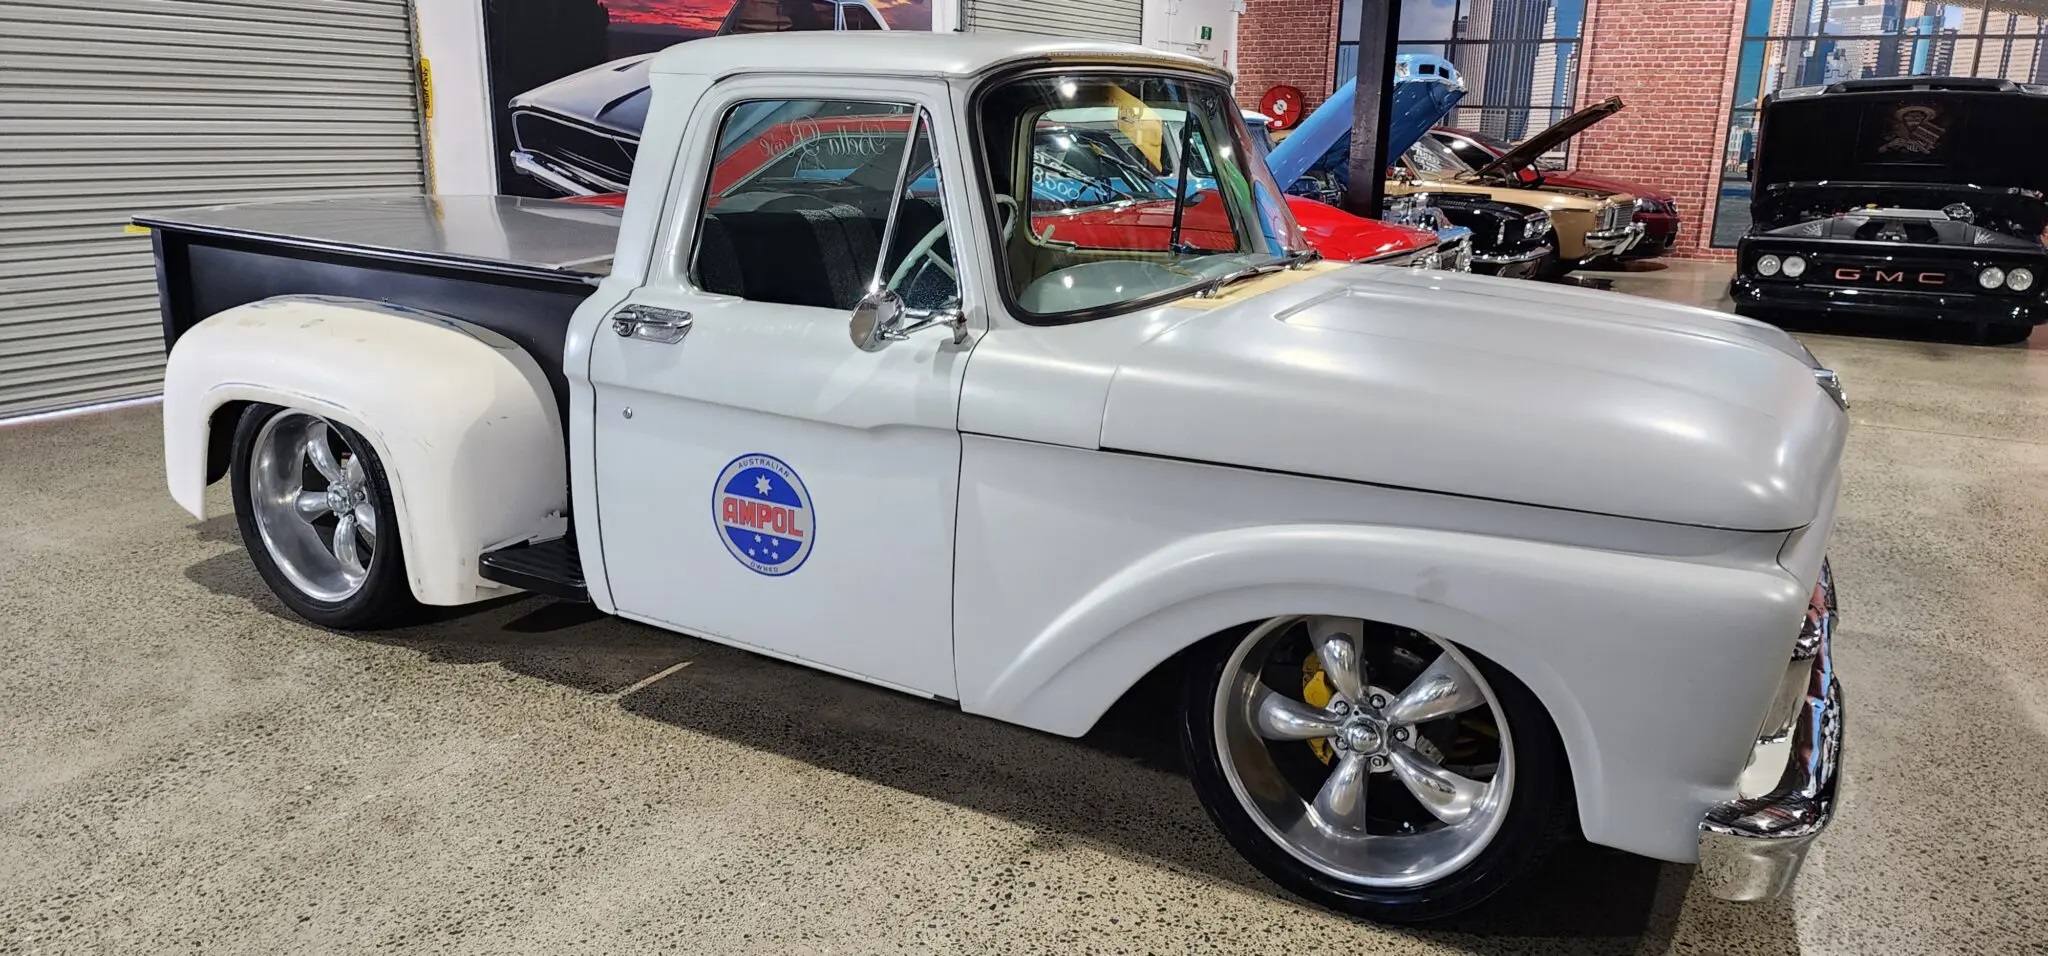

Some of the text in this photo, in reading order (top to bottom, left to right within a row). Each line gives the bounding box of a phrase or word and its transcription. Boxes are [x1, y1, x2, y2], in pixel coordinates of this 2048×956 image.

[1835, 268, 1946, 284] GMC
[738, 458, 790, 478] AUSTRALIAN
[722, 496, 804, 537] AMPOL
[750, 561, 779, 573] OWNED
